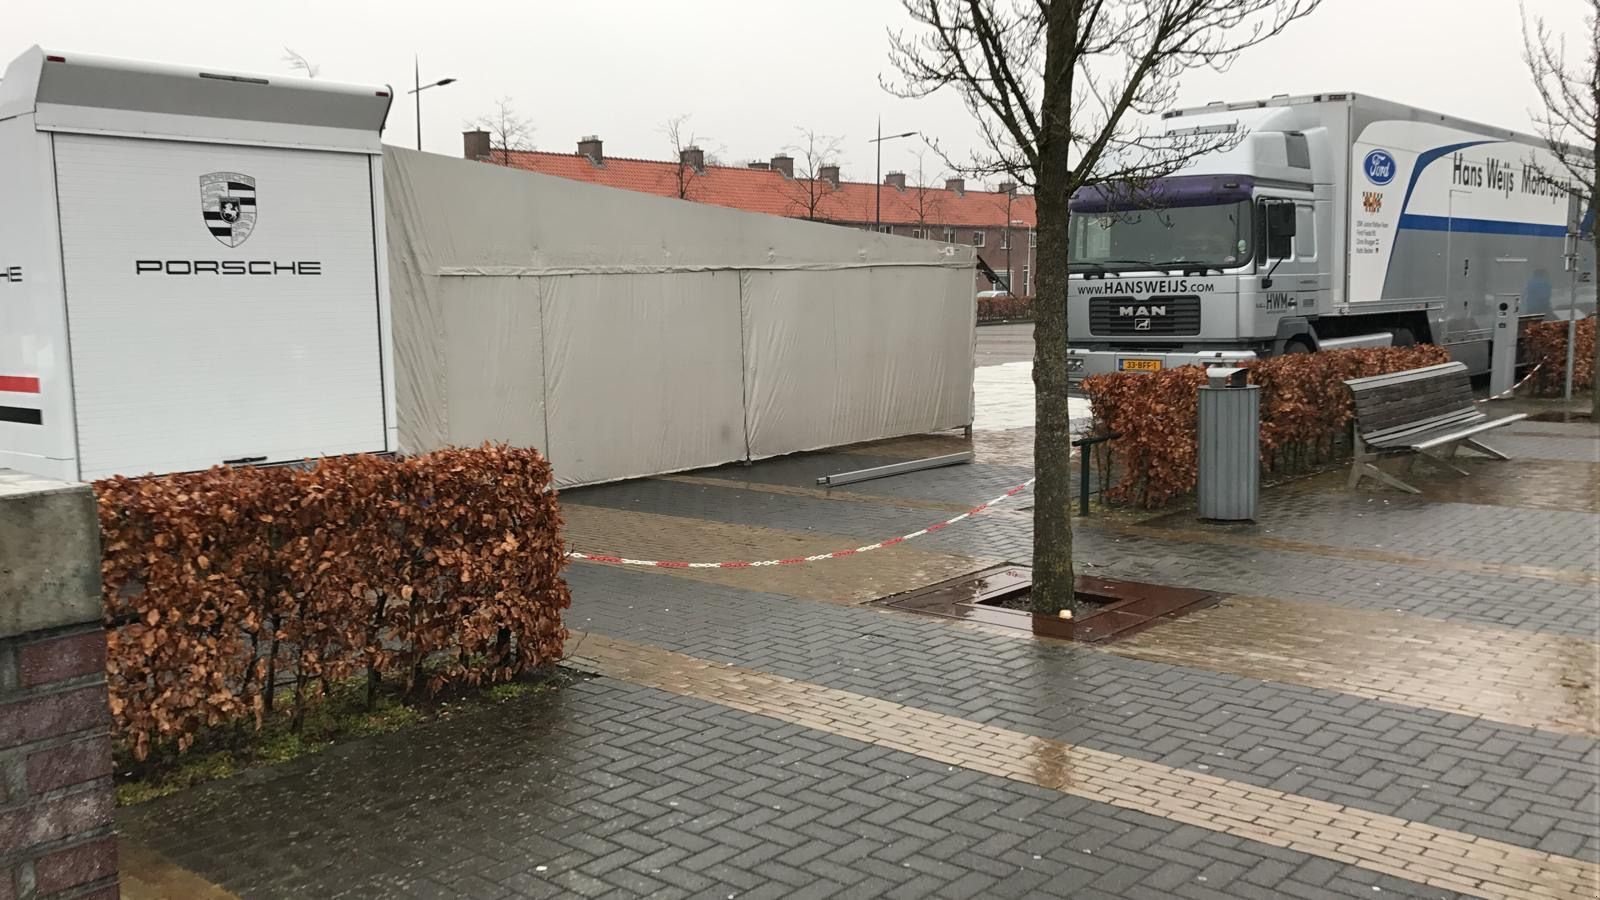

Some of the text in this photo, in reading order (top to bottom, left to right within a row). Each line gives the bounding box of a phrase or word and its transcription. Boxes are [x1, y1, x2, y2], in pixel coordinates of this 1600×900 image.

[1370, 154, 1391, 177] Ford
[1453, 152, 1482, 187] Hans
[1487, 157, 1514, 199] Weijs
[136, 260, 321, 275] PORSCHE
[1266, 292, 1287, 309] HWM
[1119, 305, 1166, 316] MAN
